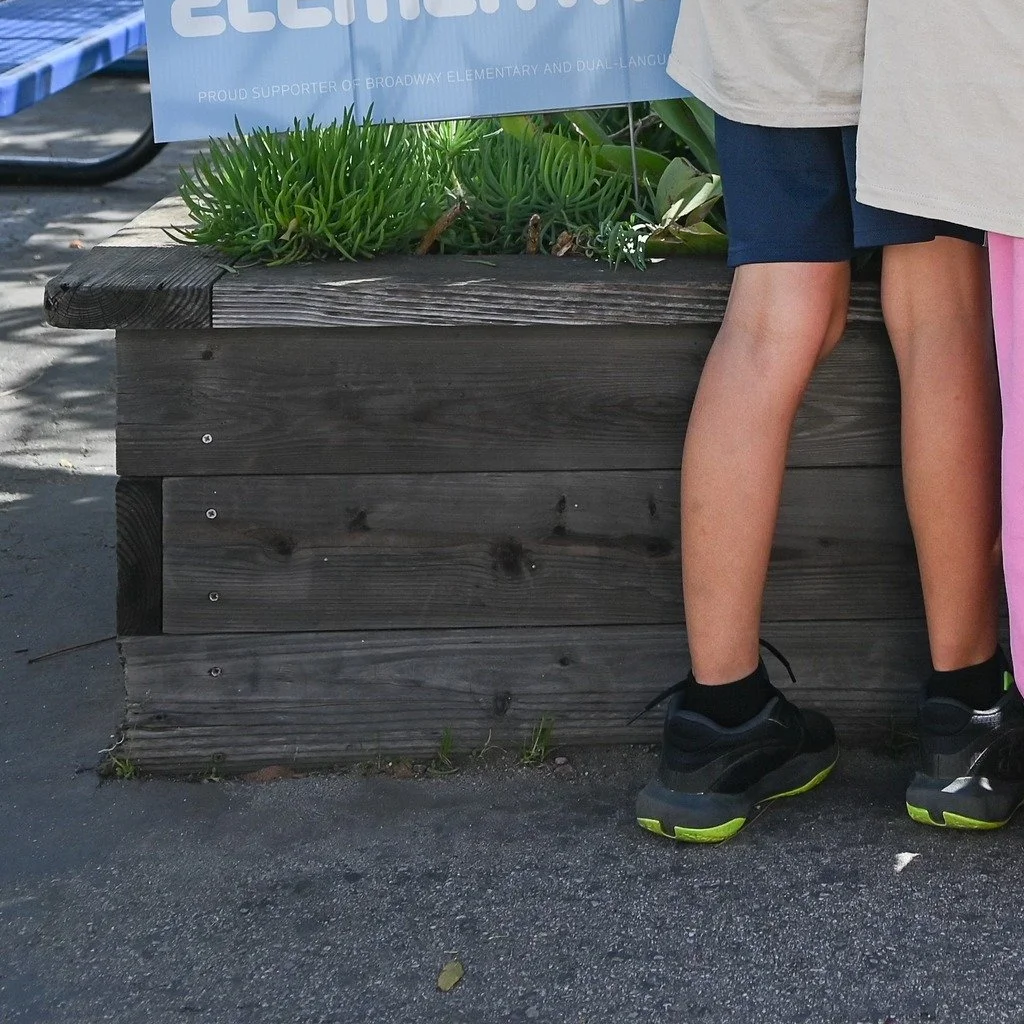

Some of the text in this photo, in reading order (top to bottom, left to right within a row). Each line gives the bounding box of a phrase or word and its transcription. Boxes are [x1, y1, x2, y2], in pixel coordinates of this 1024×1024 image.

[198, 53, 667, 103] PROUD SUPPORTER OF BROADWAY ELEMENTARY AND DUAL-LANGU
